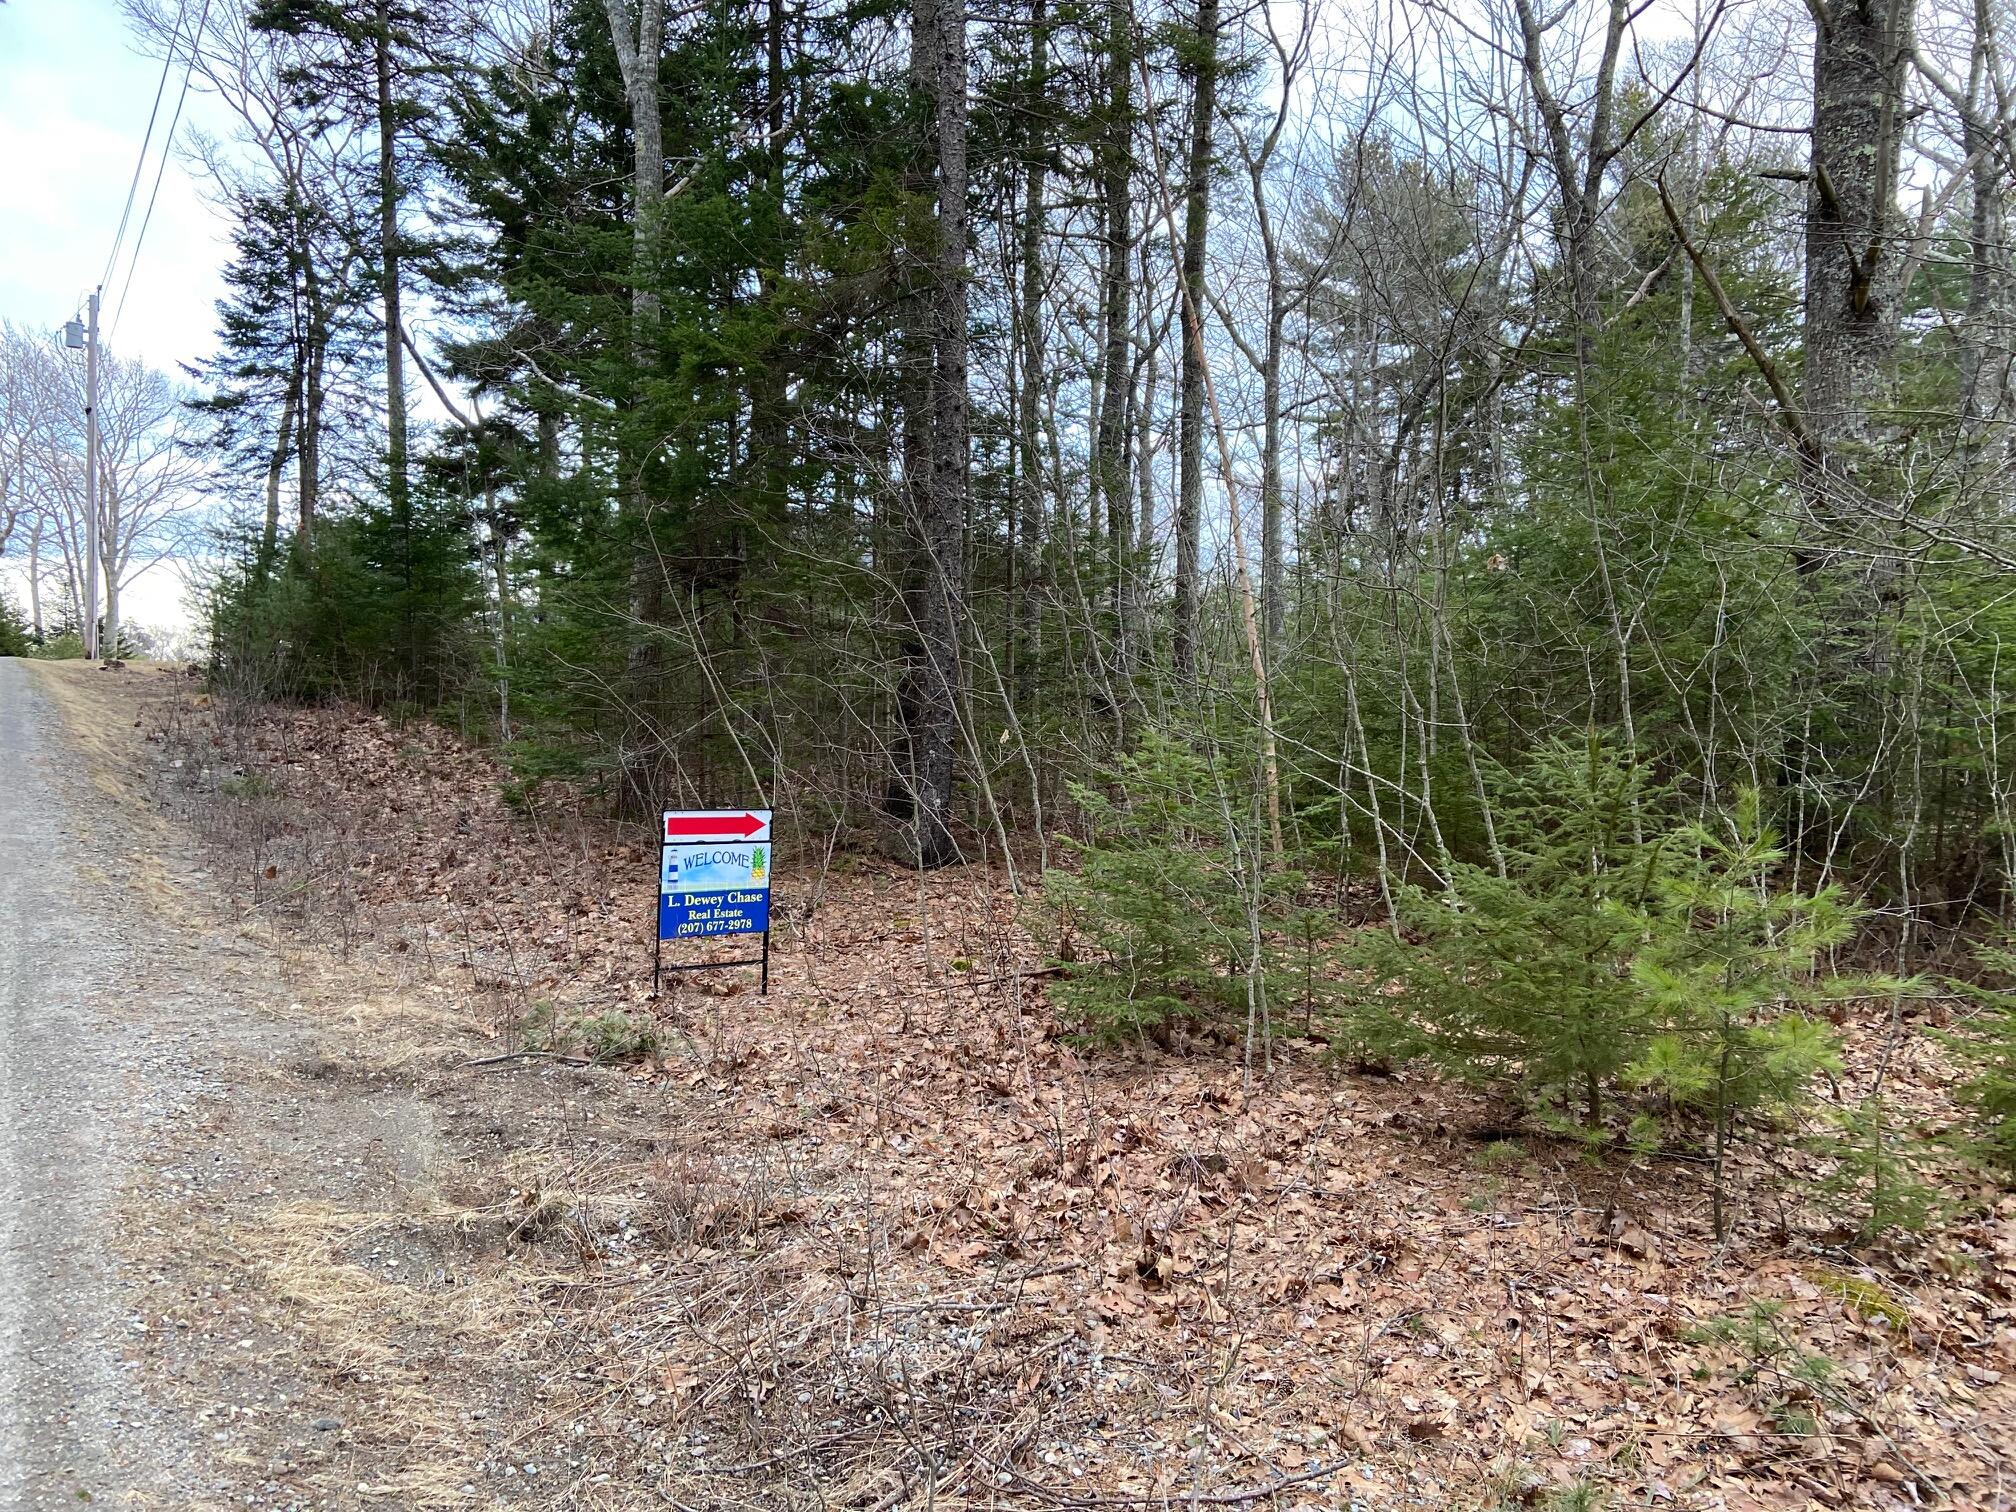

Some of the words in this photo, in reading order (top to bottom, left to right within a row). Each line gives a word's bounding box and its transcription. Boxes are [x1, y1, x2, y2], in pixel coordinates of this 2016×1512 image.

[684, 850, 750, 871] WELCOME
[668, 895, 681, 907] L.
[684, 894, 724, 908] Dewey
[727, 892, 763, 904] Chase
[688, 909, 711, 920] Real
[713, 908, 743, 919] Estate
[677, 923, 704, 935] (207)
[706, 919, 752, 932] 677-2978
